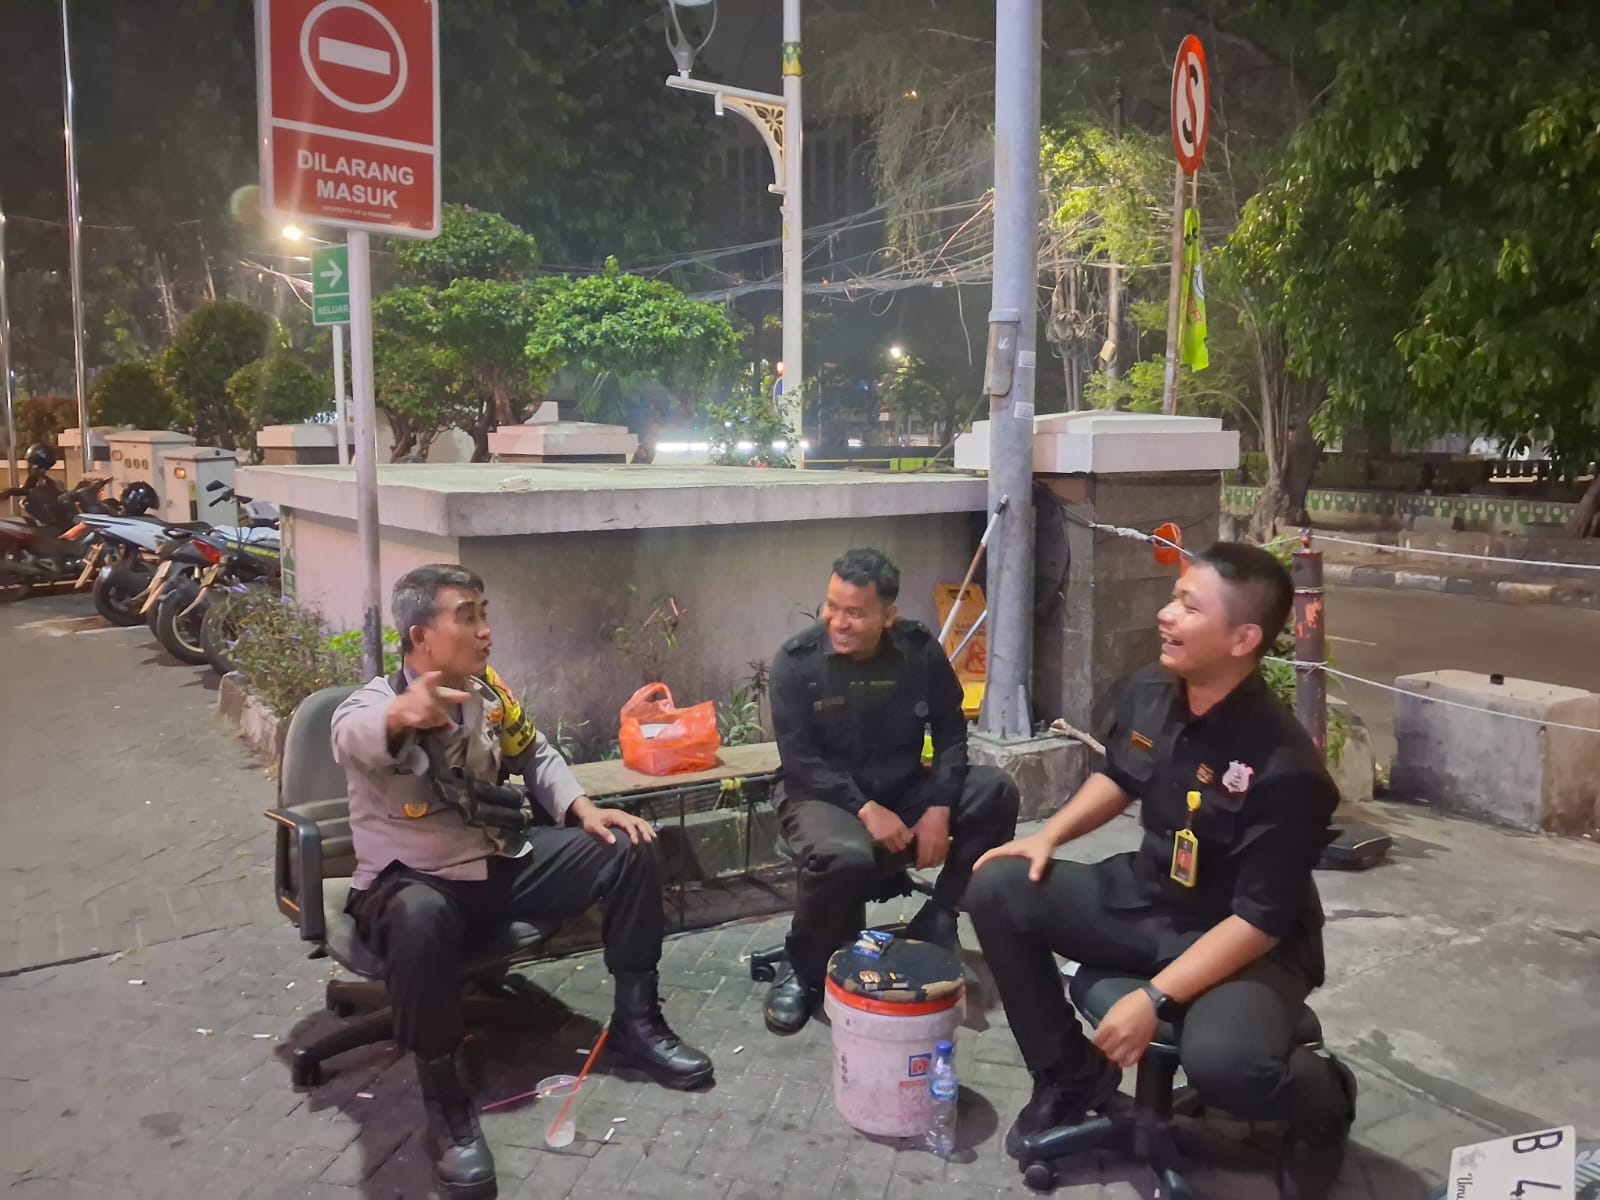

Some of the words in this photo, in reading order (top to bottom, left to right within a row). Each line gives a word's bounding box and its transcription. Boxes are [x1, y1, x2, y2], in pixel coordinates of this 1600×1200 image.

[297, 149, 414, 185] DILARANG
[316, 178, 398, 208] MASUK
[1513, 1130, 1563, 1154] B
